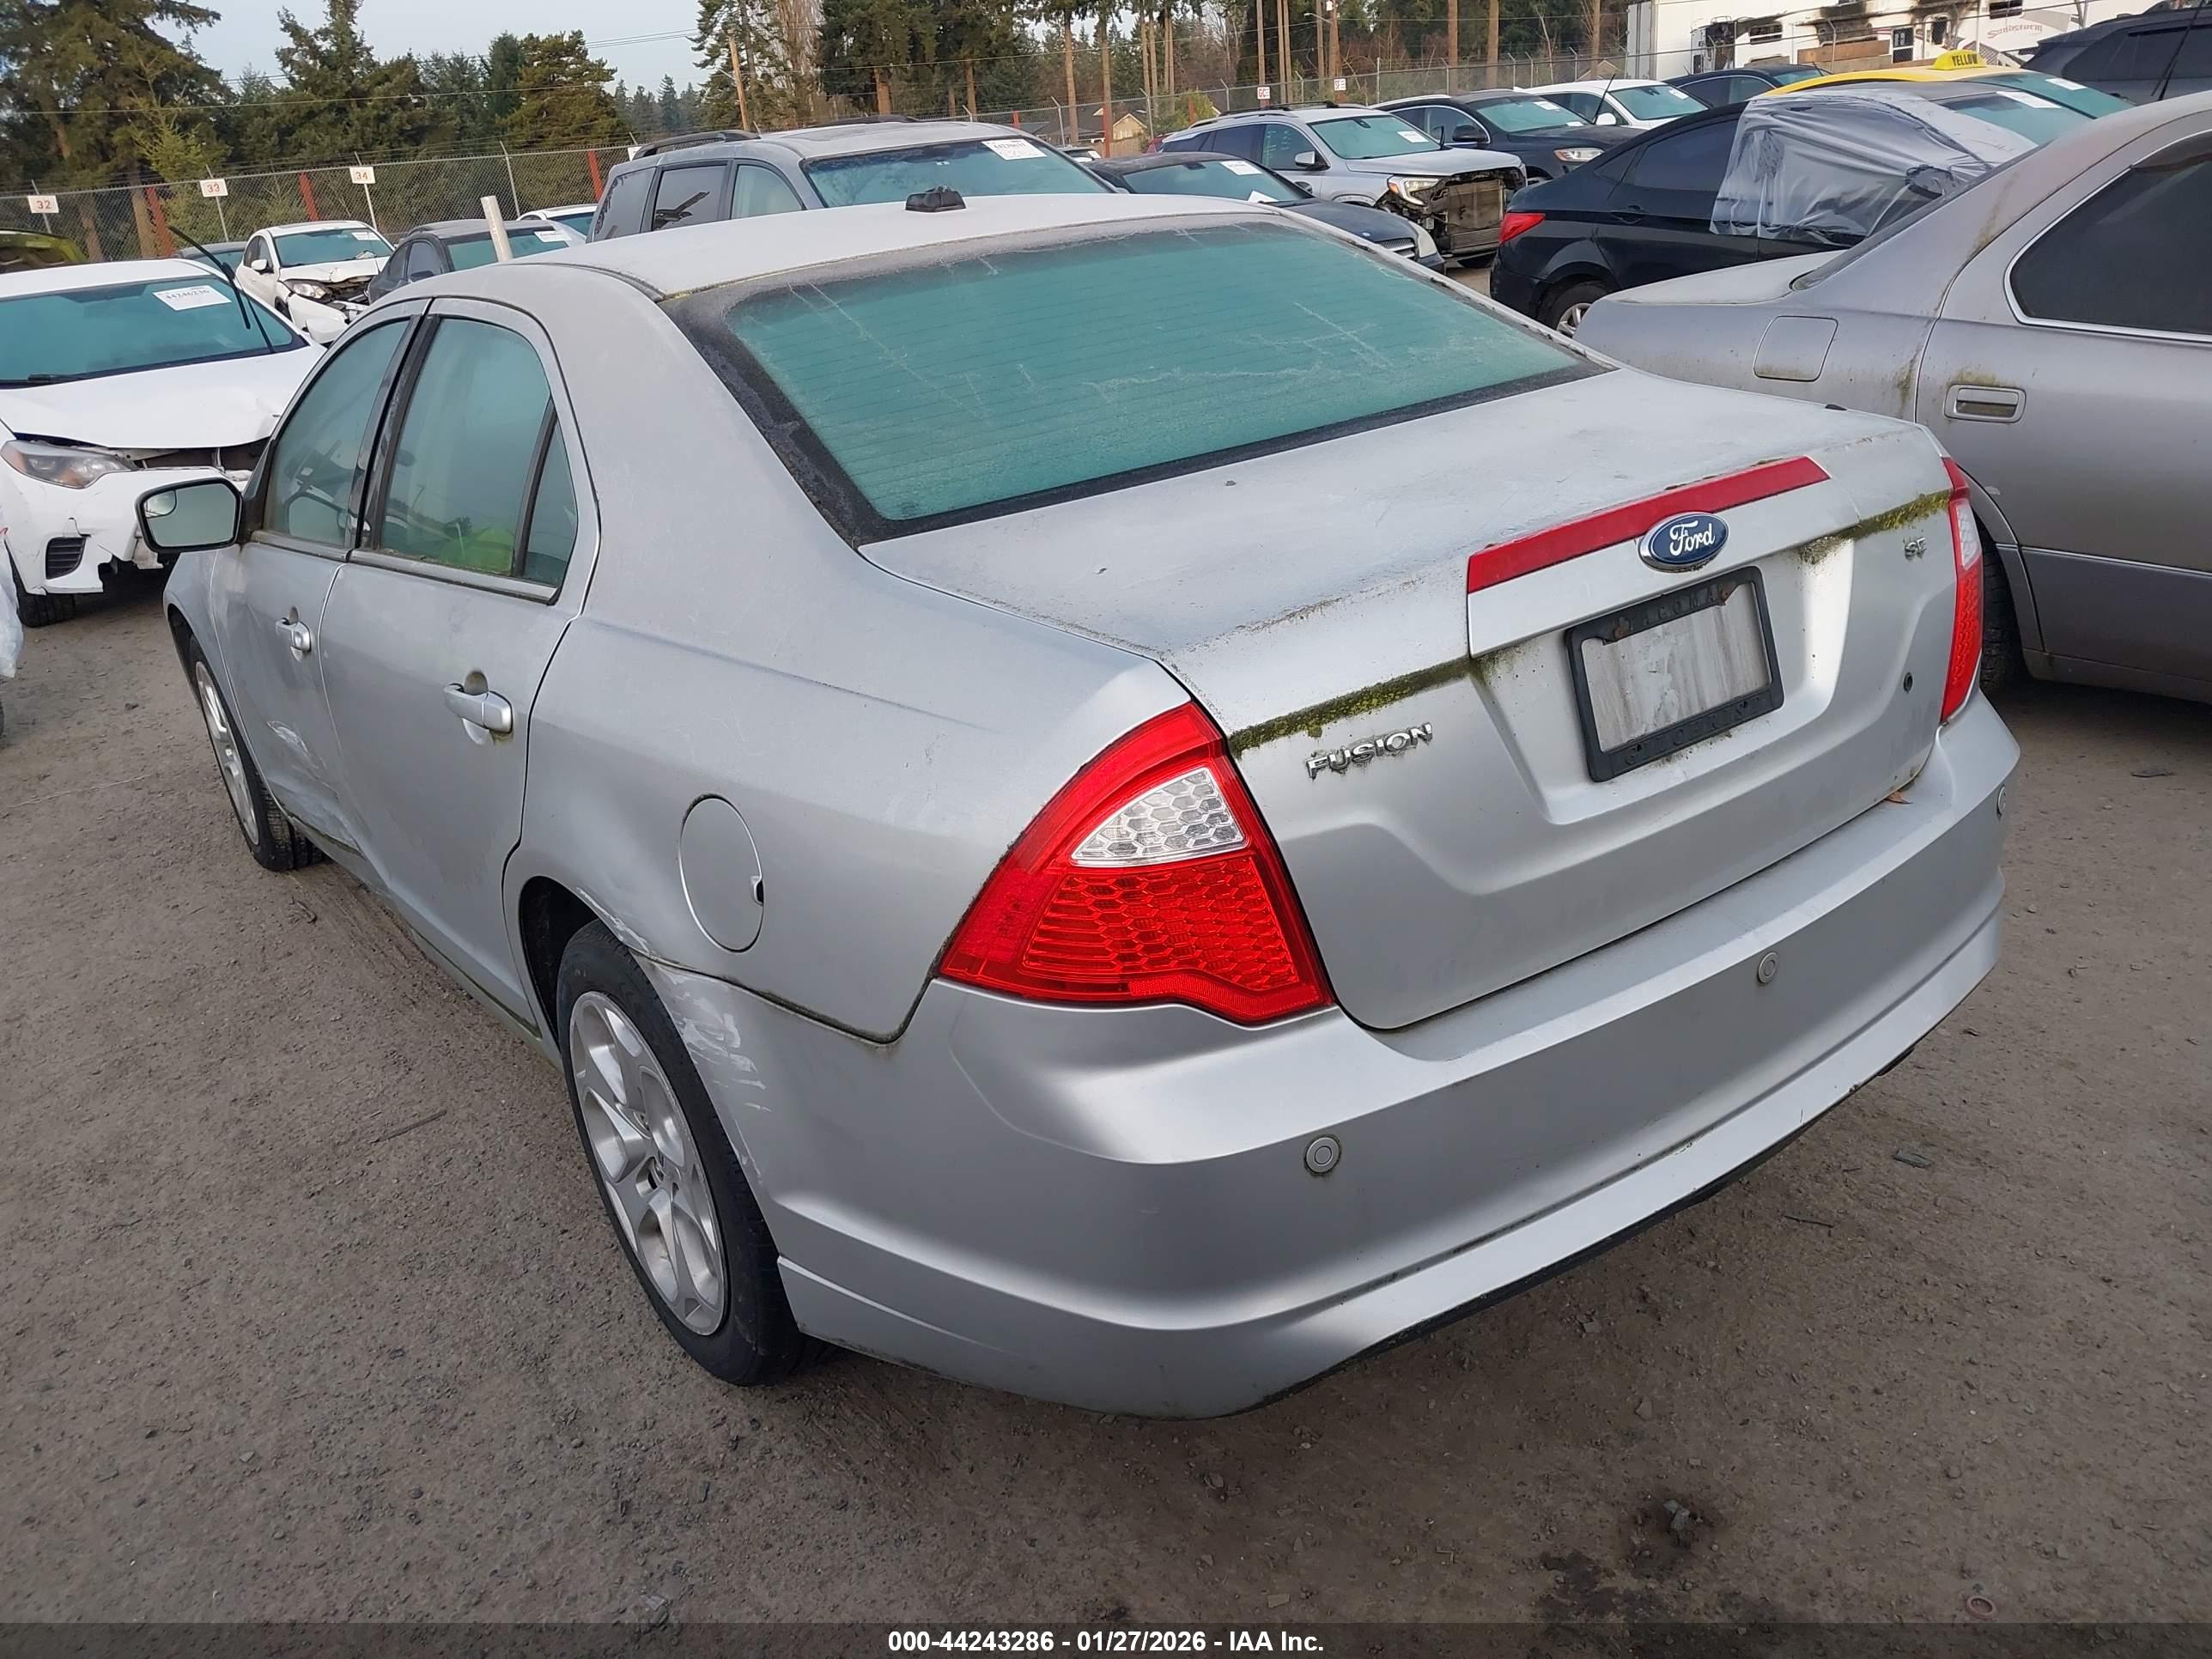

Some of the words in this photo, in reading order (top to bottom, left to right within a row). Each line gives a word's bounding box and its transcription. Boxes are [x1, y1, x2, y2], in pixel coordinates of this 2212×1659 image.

[1951, 53, 1978, 66] YELLOW
[356, 171, 368, 180] 34
[206, 183, 221, 193] 33
[36, 199, 52, 210] 32
[1669, 520, 1716, 556] Ford
[1905, 537, 1927, 558] SE
[1306, 721, 1433, 781] FUSION
